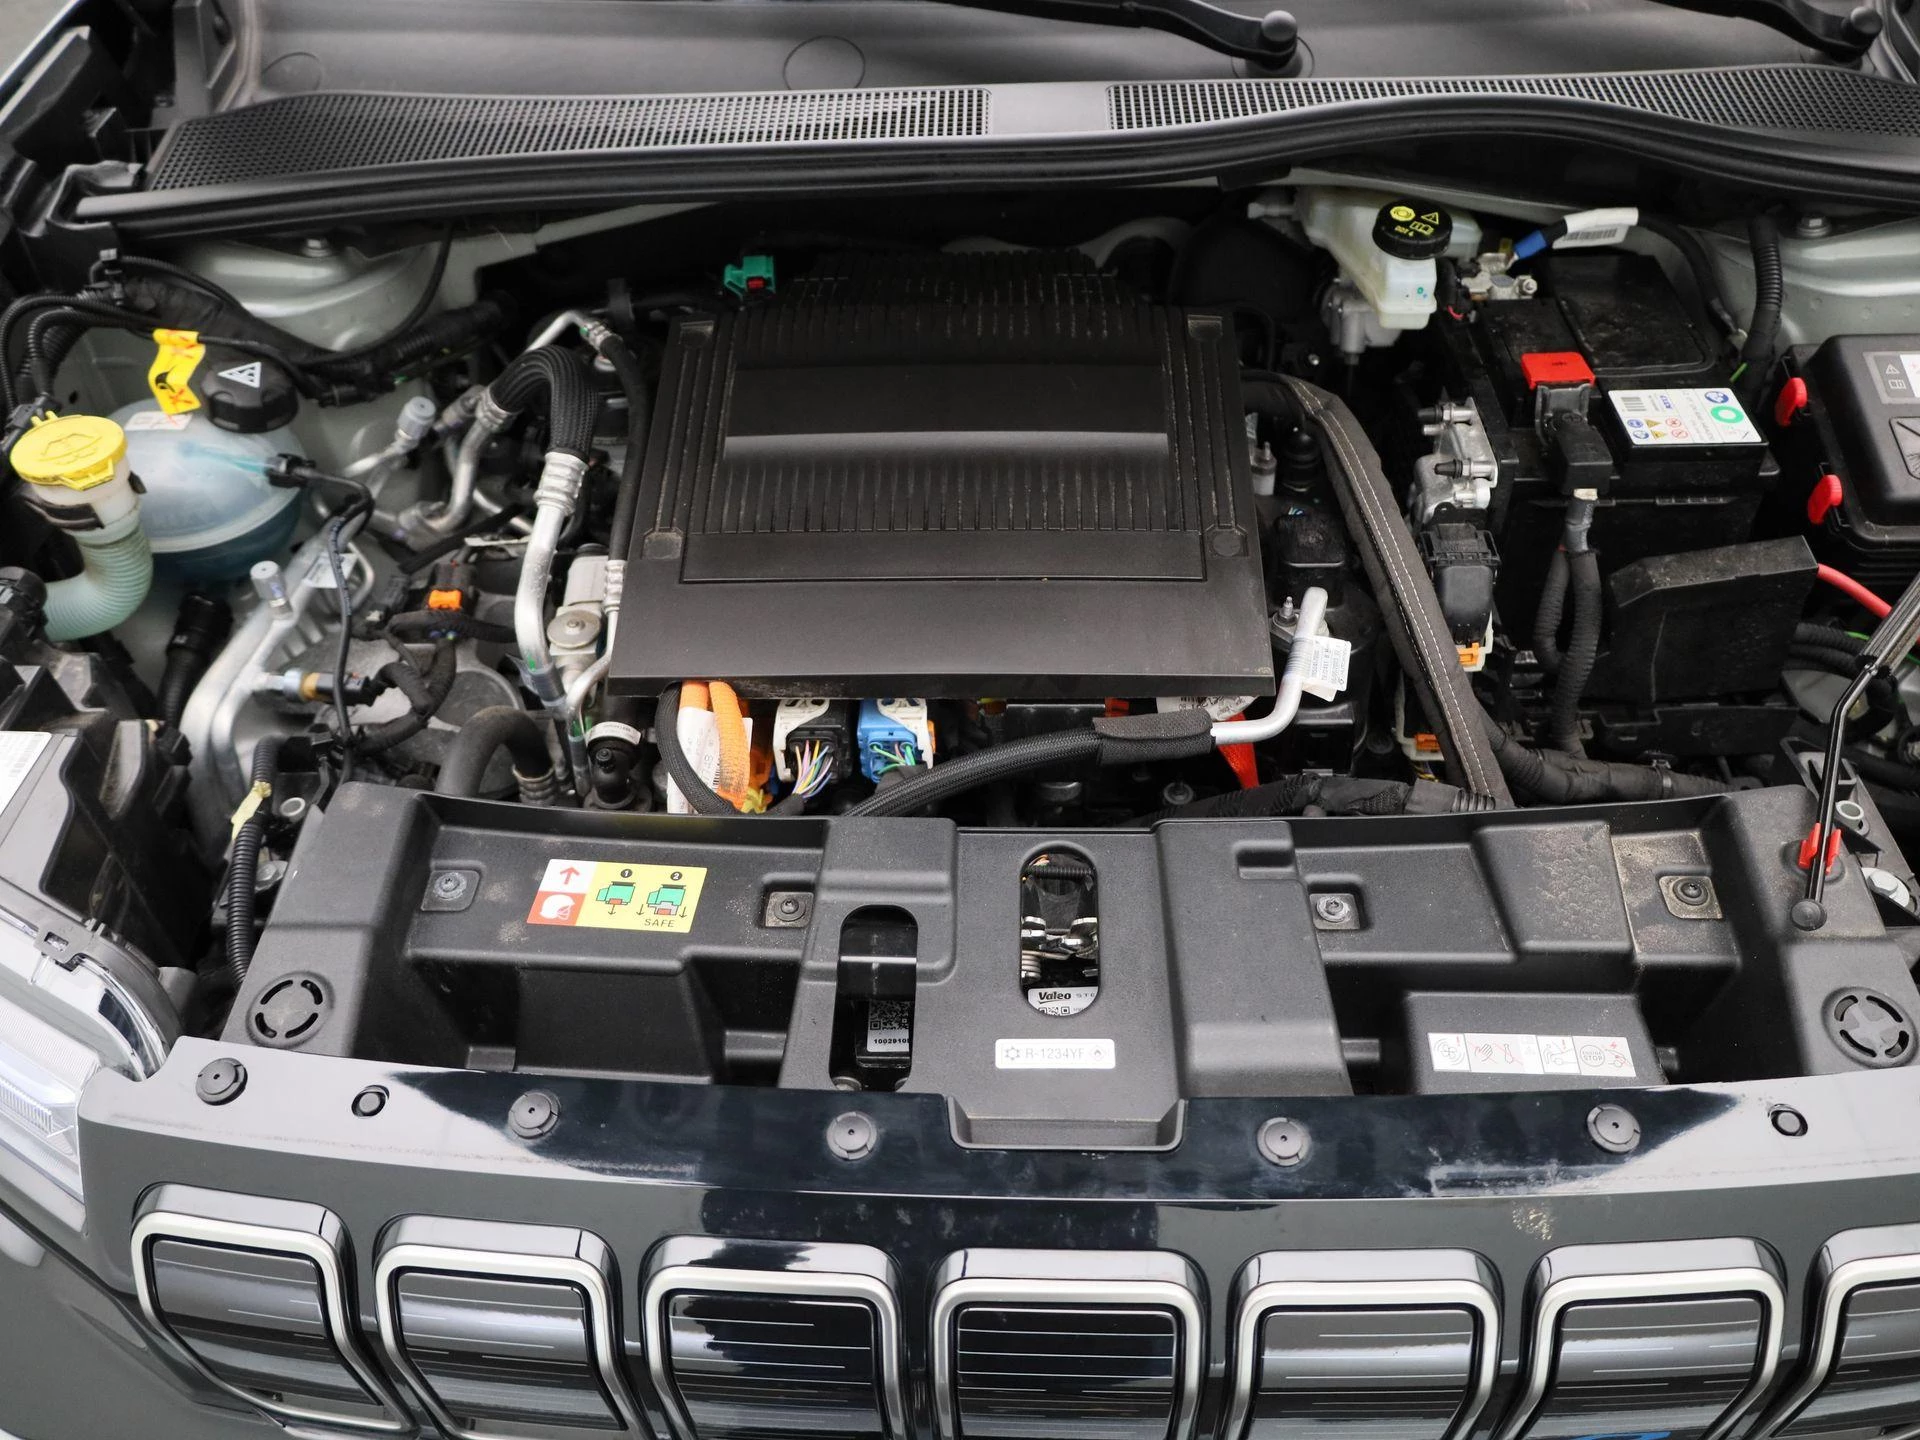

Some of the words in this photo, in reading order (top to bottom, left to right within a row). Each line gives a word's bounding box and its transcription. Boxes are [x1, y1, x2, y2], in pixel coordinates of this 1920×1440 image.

[644, 919, 675, 928] SAFE
[1039, 991, 1072, 1000] Valeo
[1025, 1047, 1085, 1059] R-1234YF
